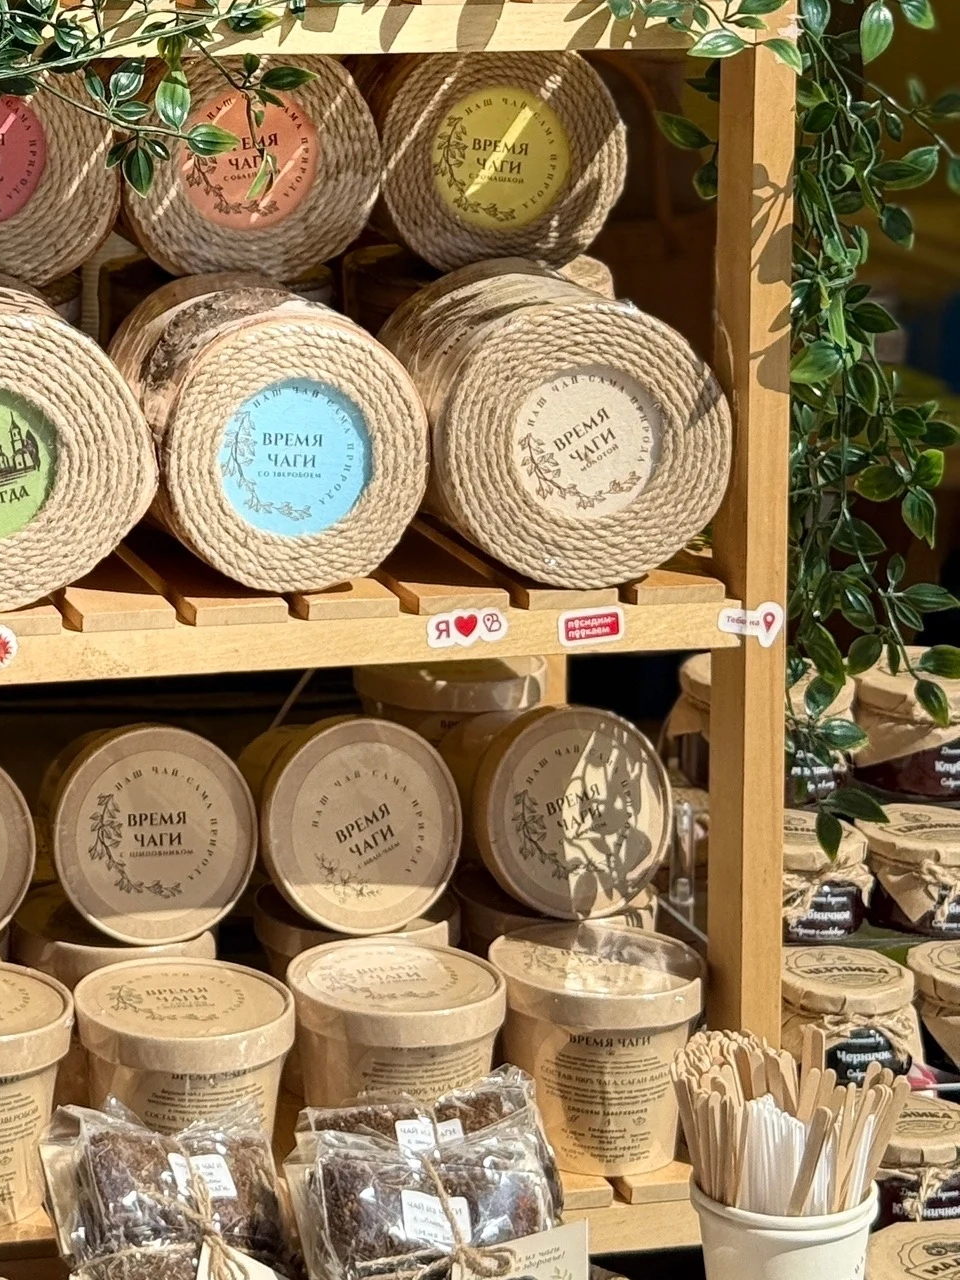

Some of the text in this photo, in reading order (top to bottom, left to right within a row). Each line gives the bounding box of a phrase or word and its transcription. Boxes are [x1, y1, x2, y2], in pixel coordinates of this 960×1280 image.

[472, 138, 529, 156] ВРЕМЯ
[476, 157, 521, 174] ЧАГИ
[552, 407, 611, 452] ВРЕМЯ
[262, 432, 323, 448] ВРЕМЯ
[568, 427, 617, 463] ЧАГИ
[267, 454, 316, 468] ЧАГИ
[434, 620, 451, 640] Я
[545, 783, 601, 816] ВРЕМЯ
[127, 811, 187, 827] ВРЕМЯ
[335, 803, 391, 844] ВРЕМЯ
[556, 805, 602, 832] ЧАГИ
[134, 832, 182, 848] ЧАГИ
[349, 824, 395, 857] ЧАГИ
[145, 987, 208, 996] ВРЕМЯ
[156, 994, 208, 1003] ЧАГИ
[569, 1034, 651, 1048] ВРЕМЯ ЧАГИ
